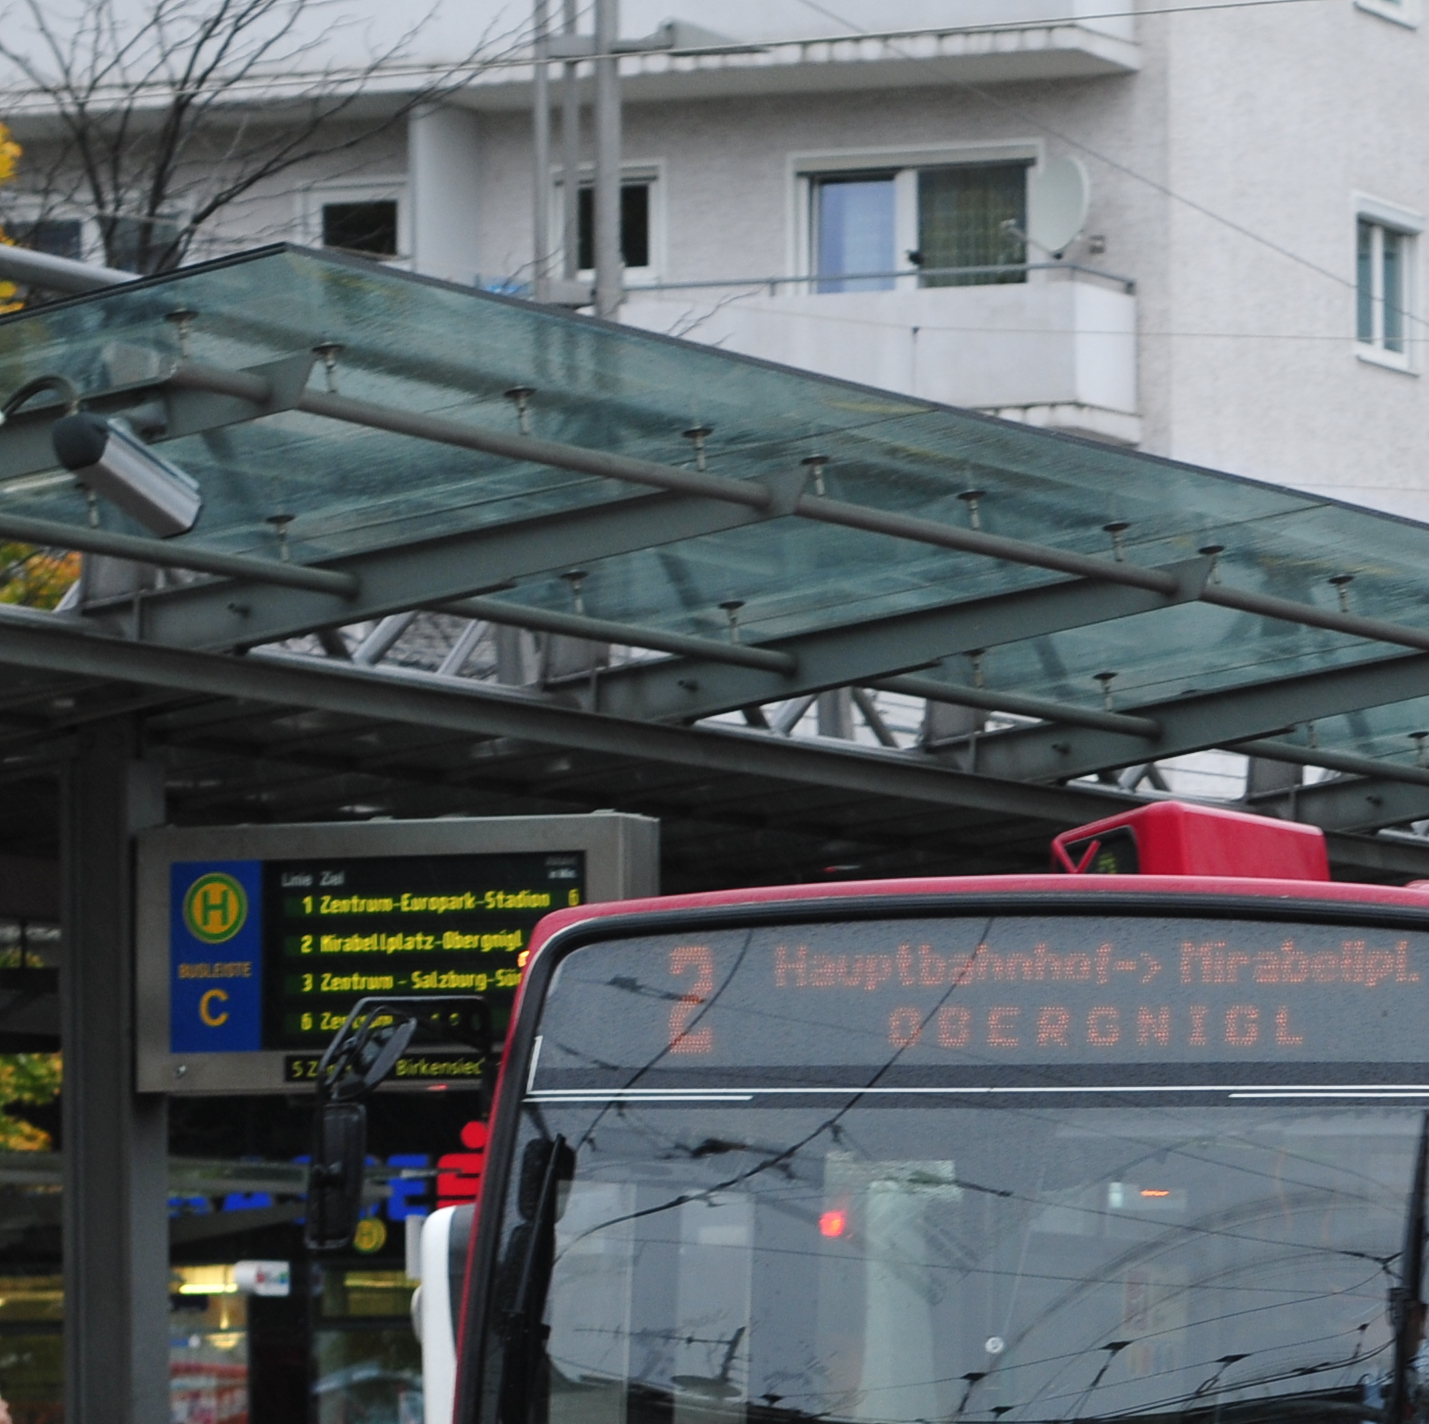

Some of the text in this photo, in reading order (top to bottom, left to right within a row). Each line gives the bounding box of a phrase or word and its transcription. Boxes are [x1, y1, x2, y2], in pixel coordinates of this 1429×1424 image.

[303, 896, 312, 914] 1
[320, 889, 550, 915] Zentrum-Europark-Stadion
[301, 930, 524, 955] 2 Mirabellplatz-Obergnigl
[302, 973, 312, 992] 3
[320, 972, 393, 992] Zentrum
[200, 988, 229, 1027] C
[669, 945, 713, 1054] 2
[301, 1013, 312, 1031] 6
[888, 1005, 1303, 1048] OBERGNIGL
